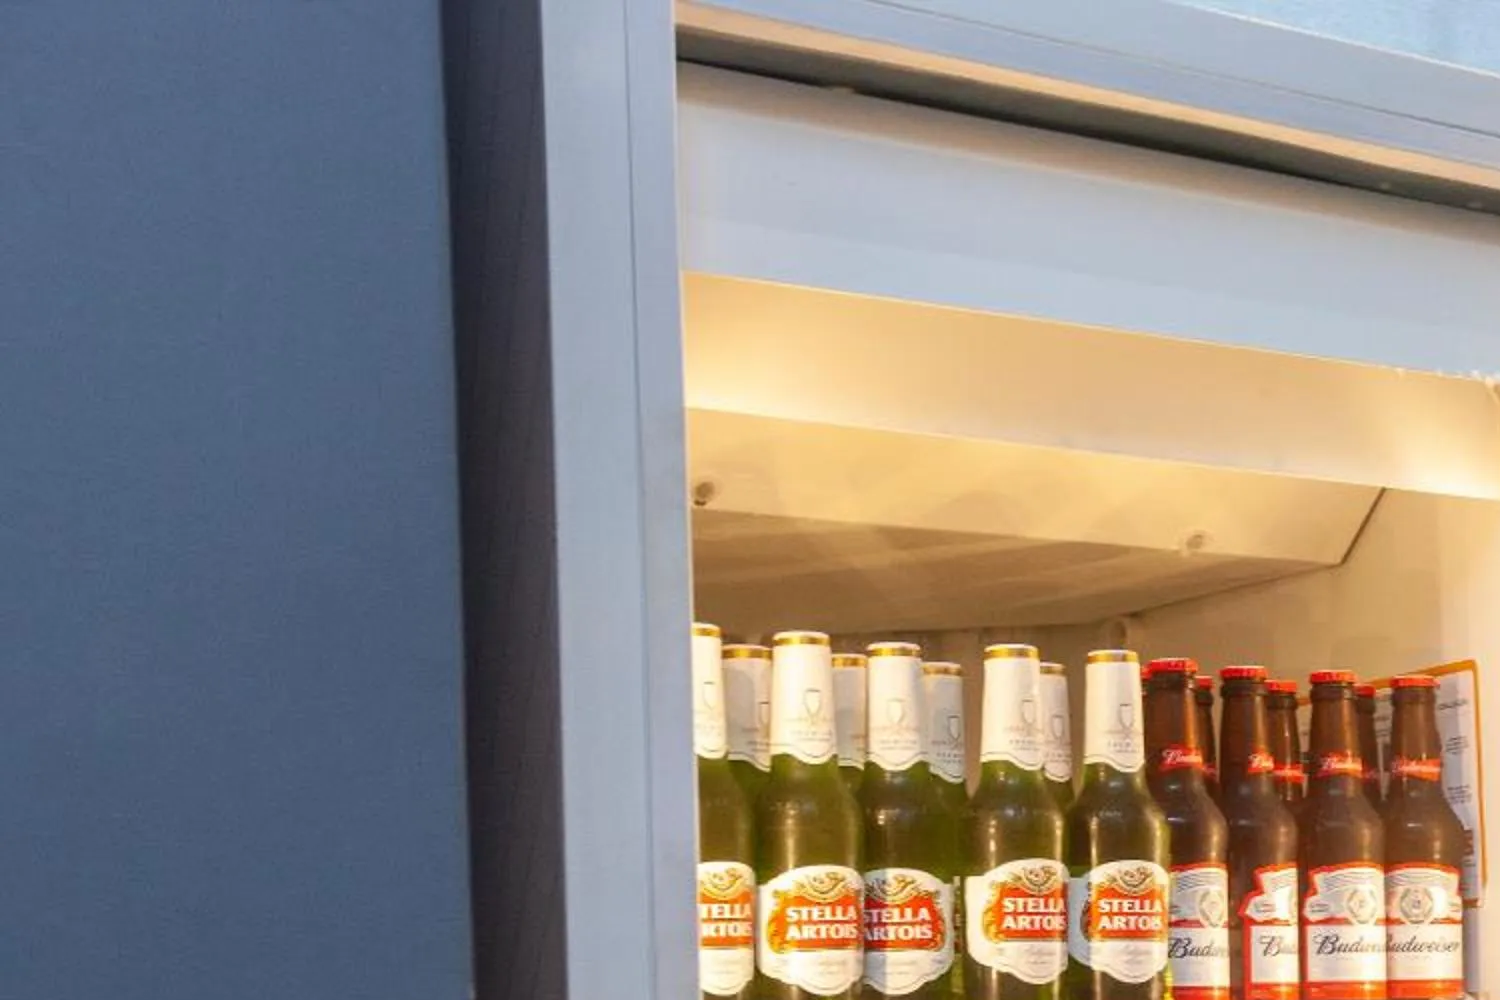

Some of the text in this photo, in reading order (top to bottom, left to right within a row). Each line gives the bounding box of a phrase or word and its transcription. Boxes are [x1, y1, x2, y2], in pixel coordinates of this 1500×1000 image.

[701, 903, 751, 918] TELLA
[785, 905, 858, 922] STELLA
[1002, 897, 1066, 913] STELLA
[1099, 898, 1163, 914] STELLA
[785, 922, 858, 940] ARTOIS
[1002, 914, 1067, 931] ARTOIS
[1099, 914, 1163, 931] ARTOIS
